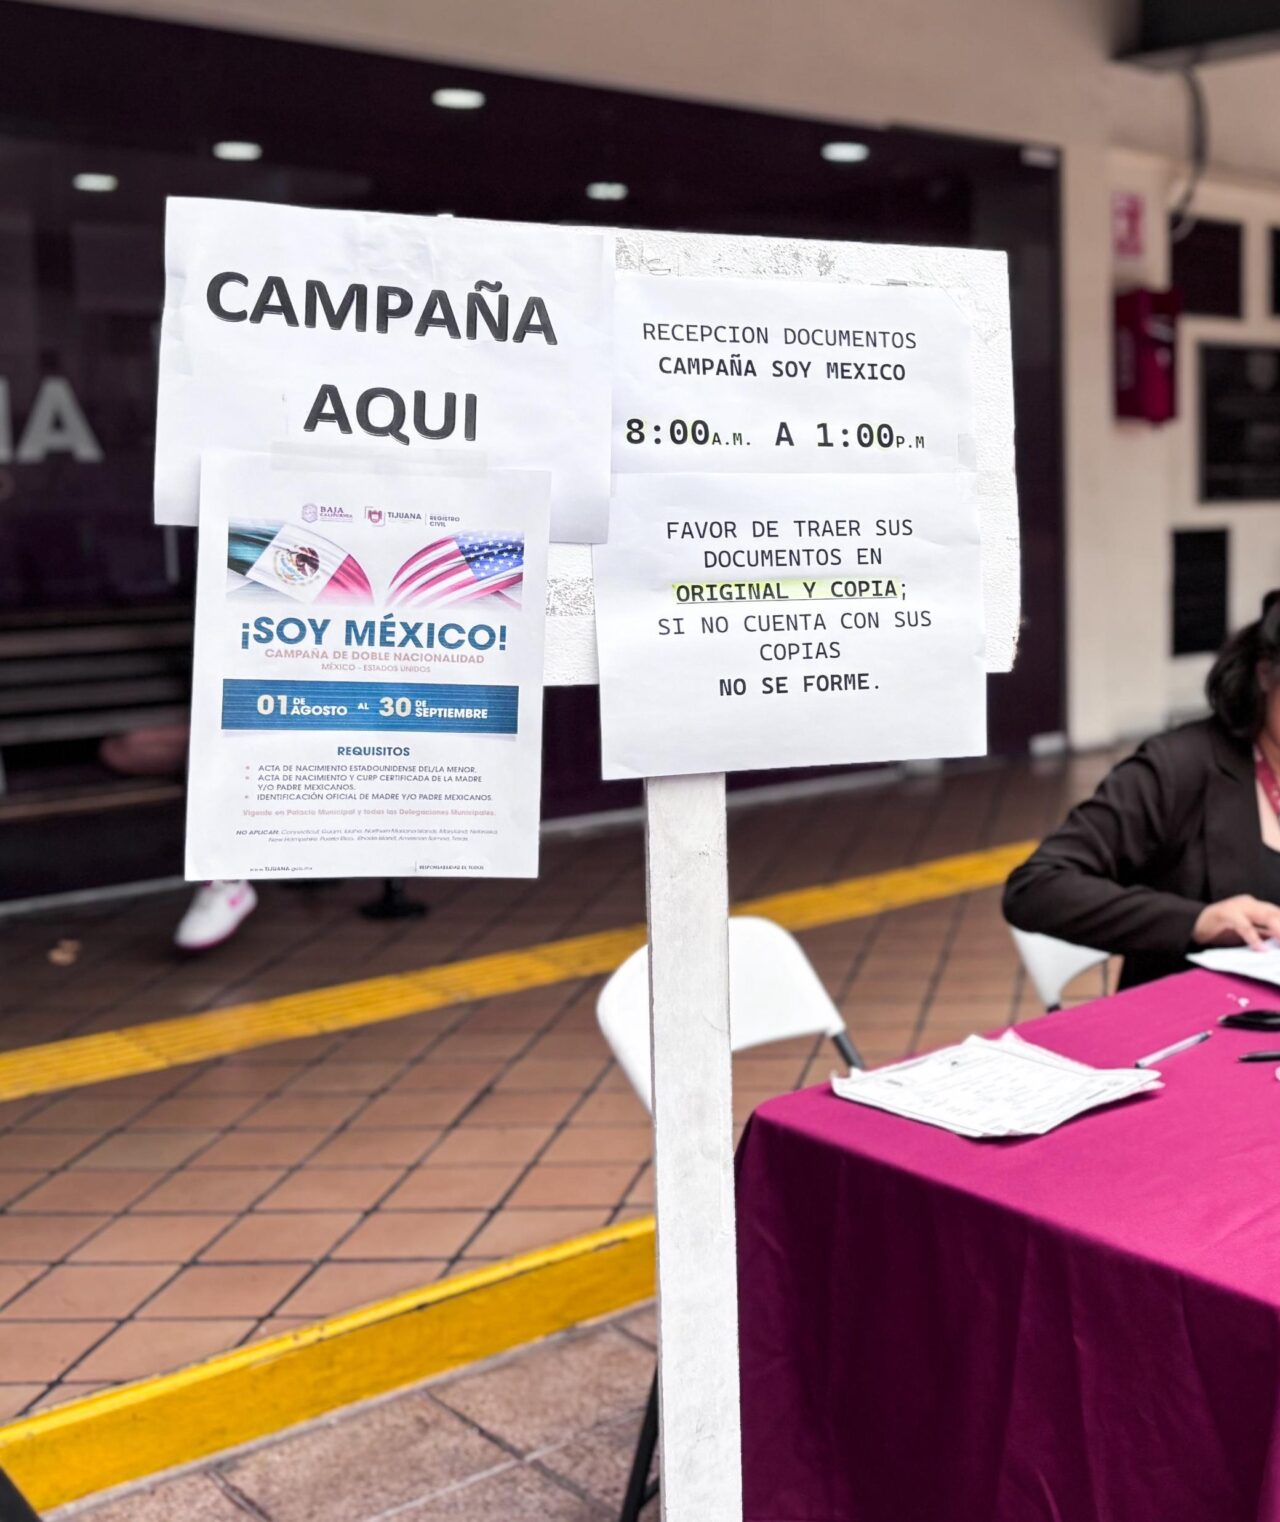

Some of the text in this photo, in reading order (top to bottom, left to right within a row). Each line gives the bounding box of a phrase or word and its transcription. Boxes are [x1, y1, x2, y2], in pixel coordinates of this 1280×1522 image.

[206, 270, 558, 346] CAMPAÑA
[642, 323, 917, 349] RECEPCION DOCUMENTOS
[658, 354, 906, 381] CAMPAÑA SOY MEXICO
[303, 383, 477, 446] AQUI
[775, 422, 795, 447] A
[320, 506, 344, 514] BAJA
[387, 511, 422, 520] TIJUANA
[667, 519, 914, 540] FAVOR DE TRAER SUS
[704, 548, 882, 569] DOCUMENTOS EN
[676, 580, 907, 603] ORIGINAL Y COPIA;
[241, 613, 507, 651] ¡SOY MÉXICO!
[658, 610, 932, 635] SI NO CUENTA CON SUS
[265, 647, 485, 664] CAMPAÑA DE DOBLE NACIONALIDAD
[759, 641, 841, 661] COPIAS
[321, 662, 355, 671] MÉXICO
[363, 664, 398, 672] ESTADOS
[719, 673, 880, 697] NO SE FORME.
[257, 695, 488, 720] 01 DE AGOSTO AL 30 DE SEPTIEMBRE
[337, 746, 410, 757] REQUISITOS
[258, 764, 281, 772] ACTA
[283, 764, 293, 772] DE
[296, 764, 348, 772] NACIMIENTO
[350, 765, 416, 773] ESTADOUNIDENSE
[418, 765, 445, 773] DEL/LA
[282, 774, 293, 782] DE
[295, 774, 348, 782] NACIMIENTO
[444, 775, 453, 783] LA
[455, 775, 483, 783] MADRE
[257, 792, 324, 800] IDENTIFICACIÓN
[419, 793, 443, 801] PADRE
[258, 783, 275, 791] Y/O
